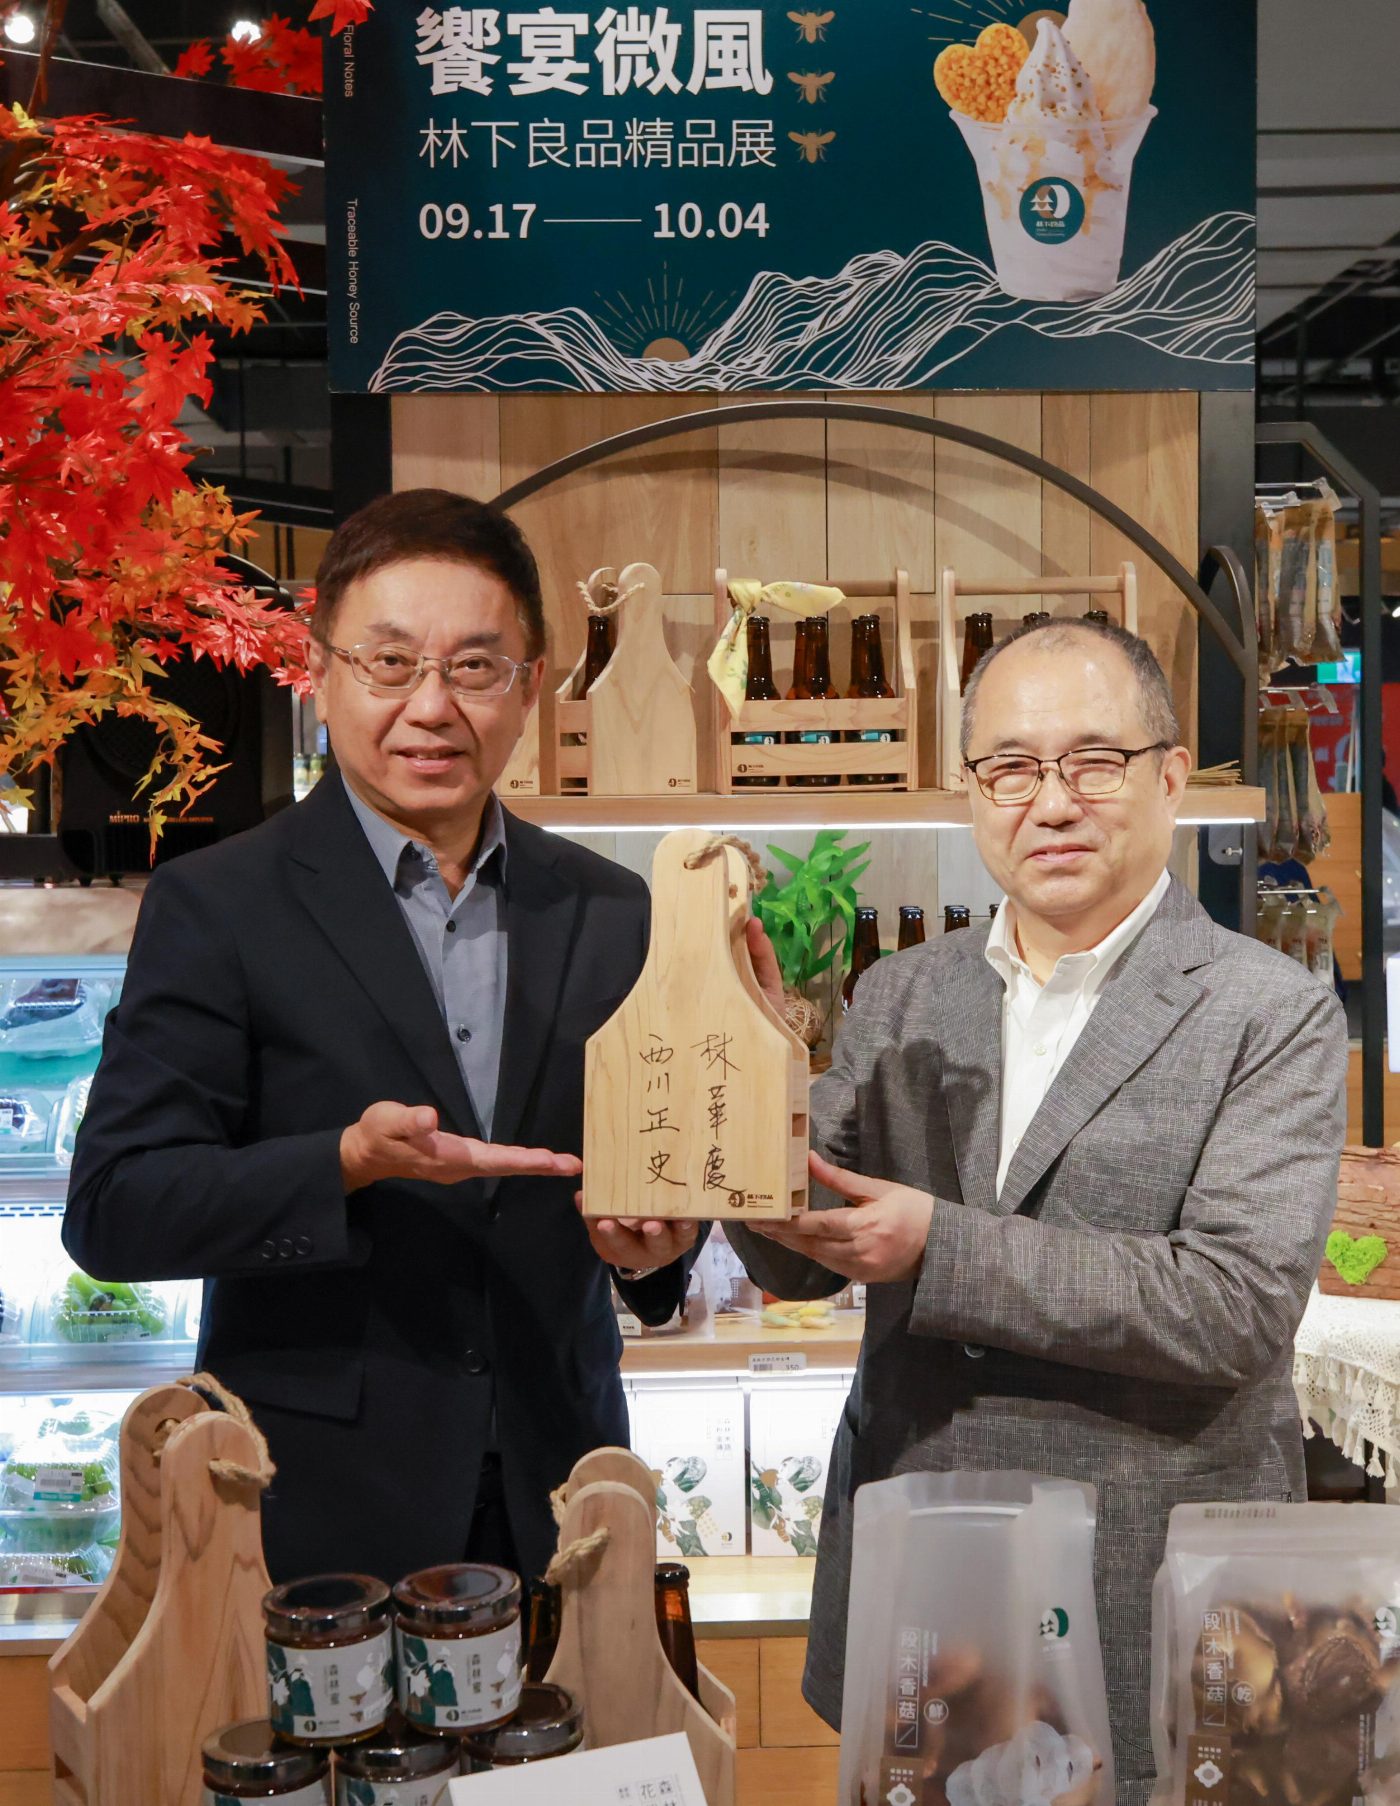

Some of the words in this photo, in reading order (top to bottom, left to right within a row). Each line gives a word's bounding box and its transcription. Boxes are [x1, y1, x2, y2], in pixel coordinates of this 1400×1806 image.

[344, 24, 355, 58] Floral
[414, 6, 774, 97] 饗宴微風
[344, 62, 355, 97] Notes
[418, 117, 777, 168] 林下良品精品展
[347, 198, 359, 257] Traceable
[418, 203, 537, 240] 09.17
[653, 202, 770, 239] 10.04
[347, 261, 359, 298] Honey
[349, 302, 360, 344] Source
[898, 1631, 919, 1720] 段木香菇
[1203, 1613, 1224, 1703] 段木香菇
